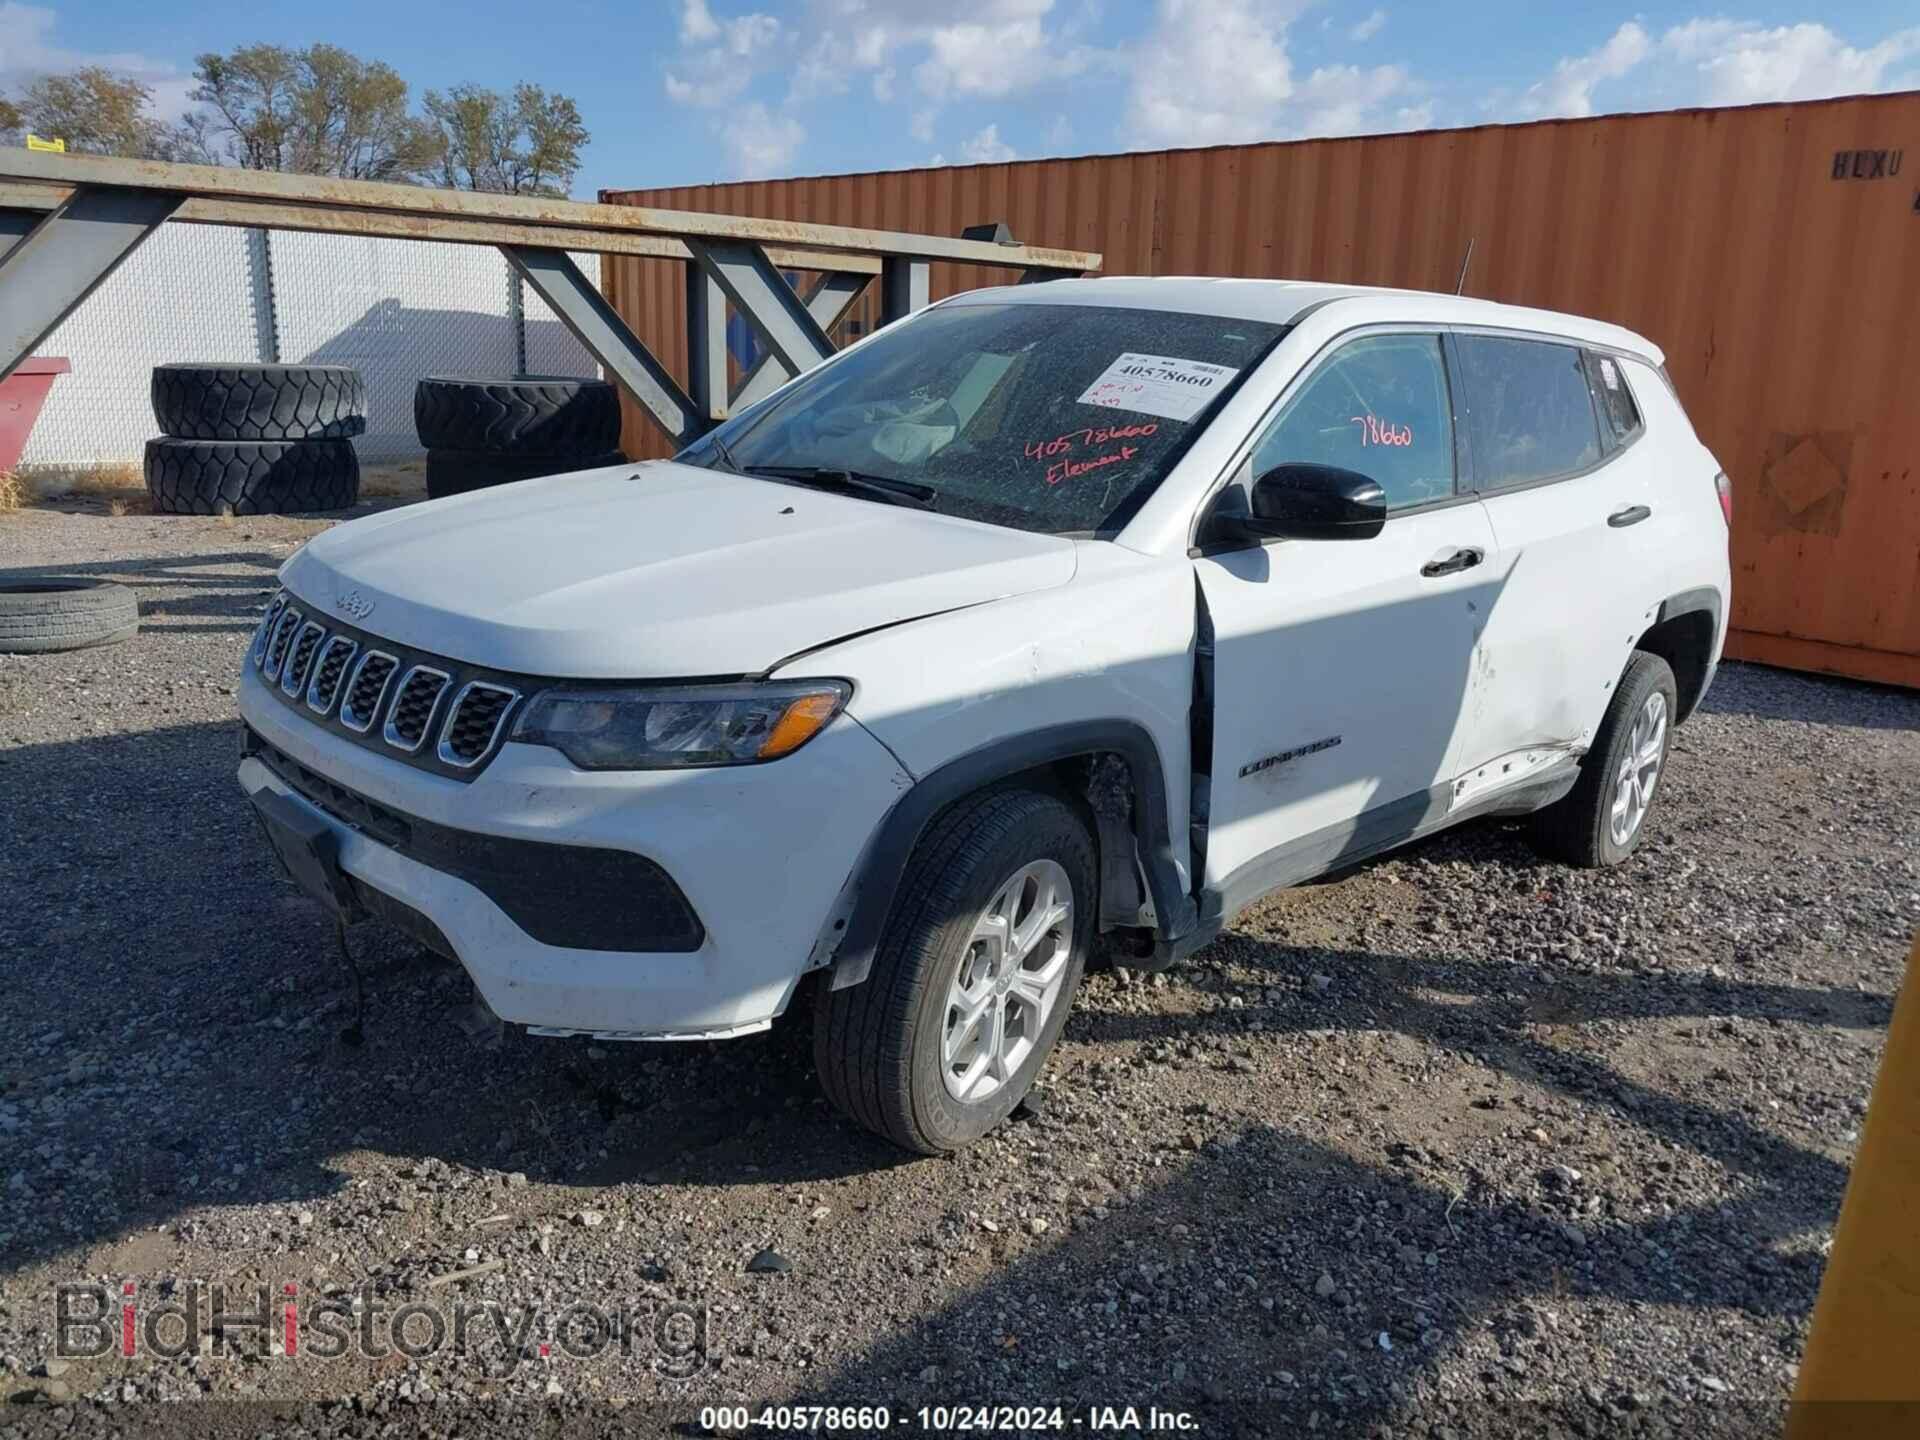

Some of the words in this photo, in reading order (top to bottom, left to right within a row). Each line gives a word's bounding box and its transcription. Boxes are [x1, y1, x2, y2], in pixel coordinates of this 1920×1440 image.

[1120, 364, 1213, 388] 40578660
[1351, 415, 1412, 447] 78660
[1045, 446, 1141, 486] Element
[336, 591, 377, 620] Jeep
[1238, 735, 1342, 778] COMPASS
